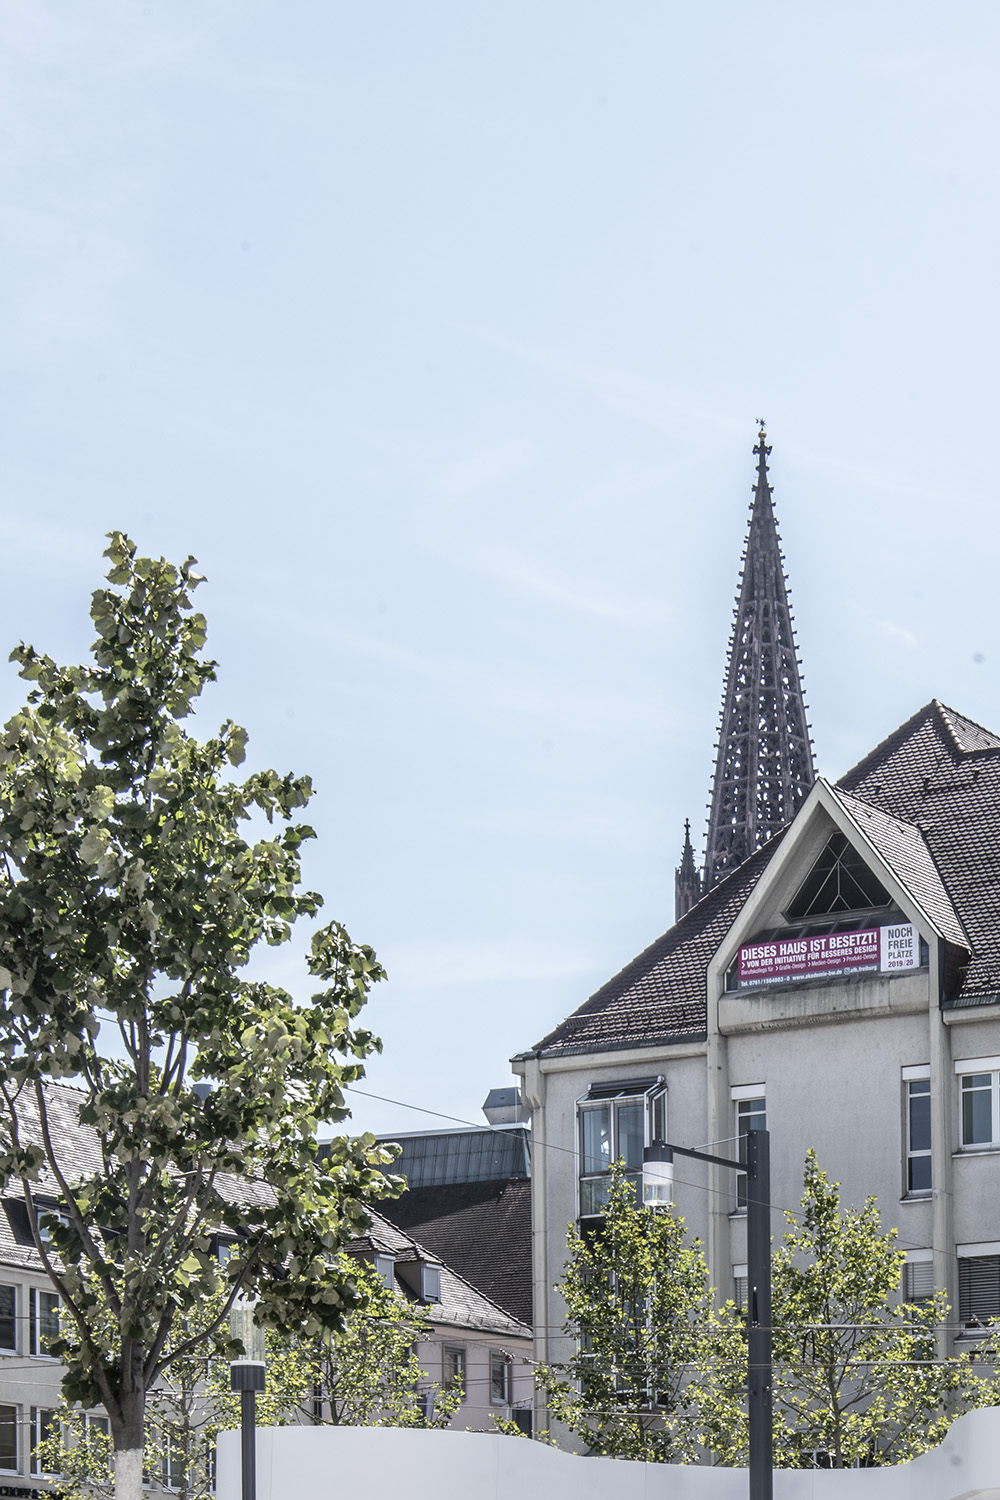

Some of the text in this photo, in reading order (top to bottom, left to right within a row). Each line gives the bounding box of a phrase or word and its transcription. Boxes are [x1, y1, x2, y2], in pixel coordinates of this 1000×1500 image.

[888, 927, 913, 939] NOCH
[741, 932, 877, 961] DIESES HAUS IST BESETZT!
[888, 938, 913, 950] FREIE
[747, 944, 878, 968] VON DER INITIATIVE FÜR BESSERES DESIGN
[888, 948, 913, 959] PLÄTZE
[888, 959, 914, 968] 2019/20
